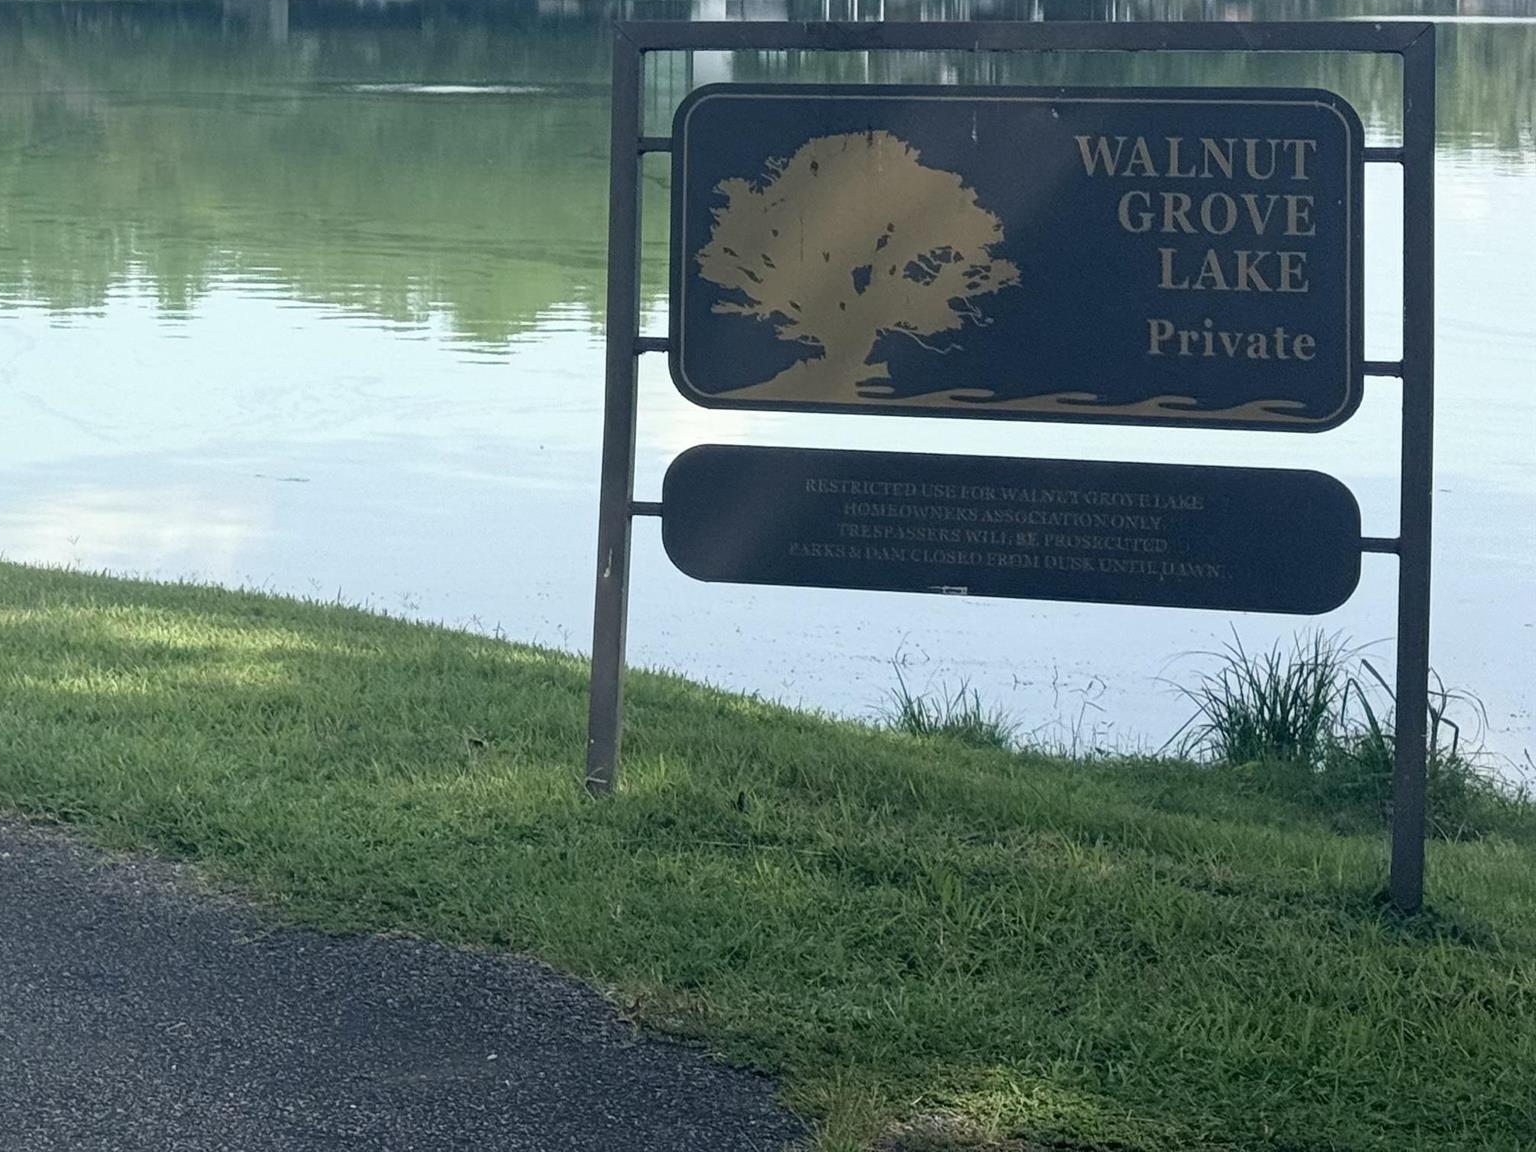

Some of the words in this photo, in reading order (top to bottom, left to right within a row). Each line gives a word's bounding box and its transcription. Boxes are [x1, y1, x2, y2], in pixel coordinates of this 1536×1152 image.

[1073, 135, 1317, 180] WALNUT
[1118, 190, 1316, 236] GROVE
[1157, 247, 1310, 292] LAKE
[1146, 318, 1316, 360] Private
[804, 478, 917, 496] RESTRICTED
[921, 483, 957, 499] USE
[960, 485, 996, 501] FOR
[1000, 487, 1081, 504] WALNUT
[1083, 491, 1152, 508] GROVE
[838, 523, 961, 542] TRESPASSERS
[844, 502, 978, 521] HOMEOWNERS
[980, 508, 1109, 528] ASSOCIATION
[1110, 514, 1162, 530] ONLY
[910, 549, 983, 565] CLOSED
[986, 552, 1041, 568] FROM
